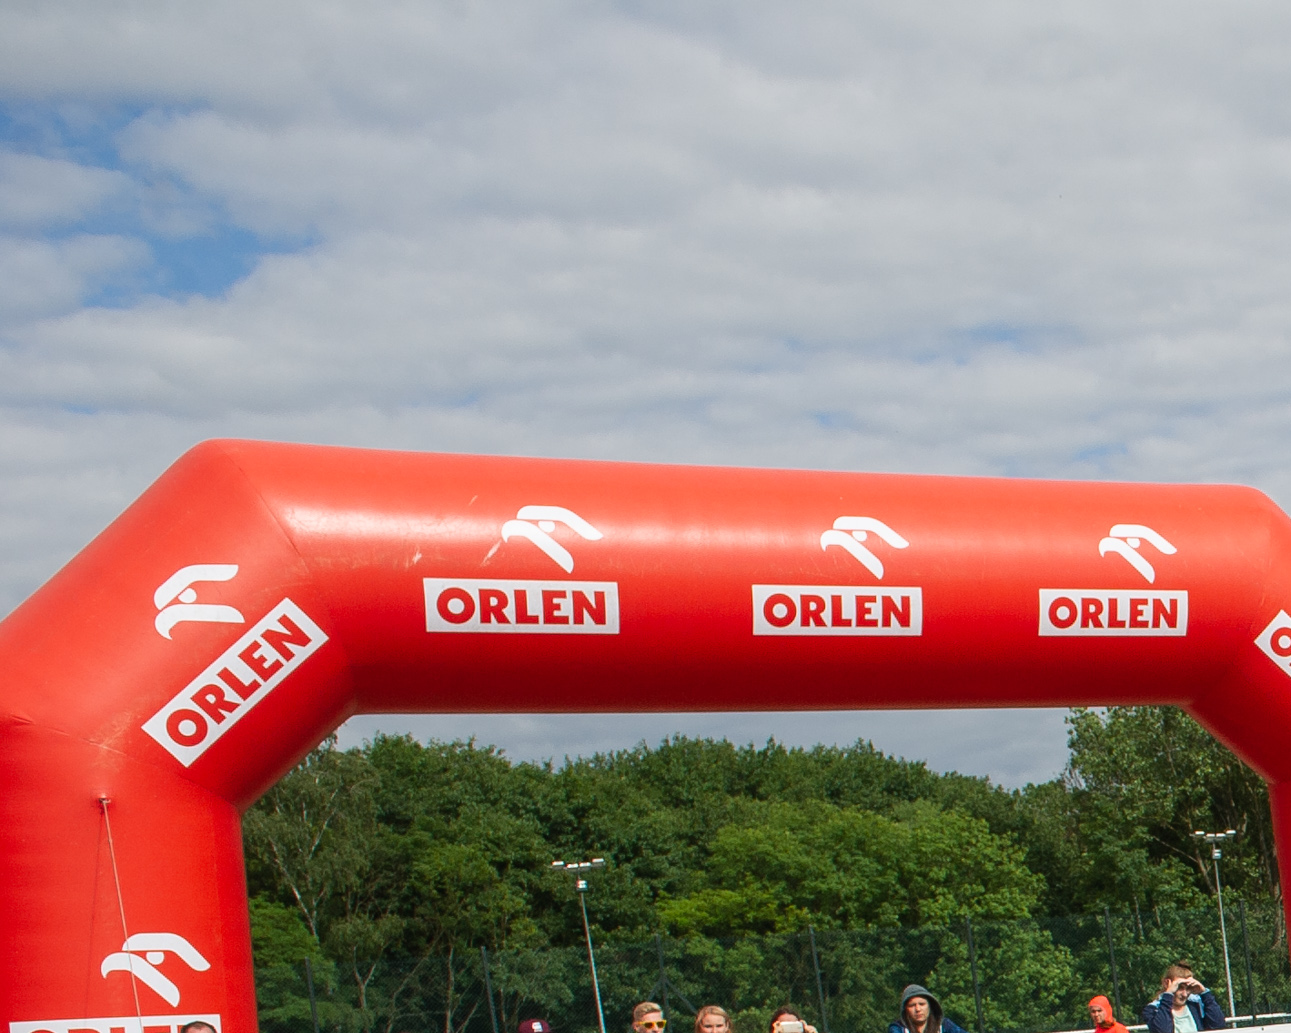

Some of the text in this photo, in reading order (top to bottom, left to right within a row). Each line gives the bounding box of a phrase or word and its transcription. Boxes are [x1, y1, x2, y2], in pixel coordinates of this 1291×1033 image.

[436, 587, 607, 626] ORLEN
[762, 592, 912, 629] ORLEN
[1047, 595, 1179, 630] ORLEN
[165, 613, 312, 749] ORLEN
